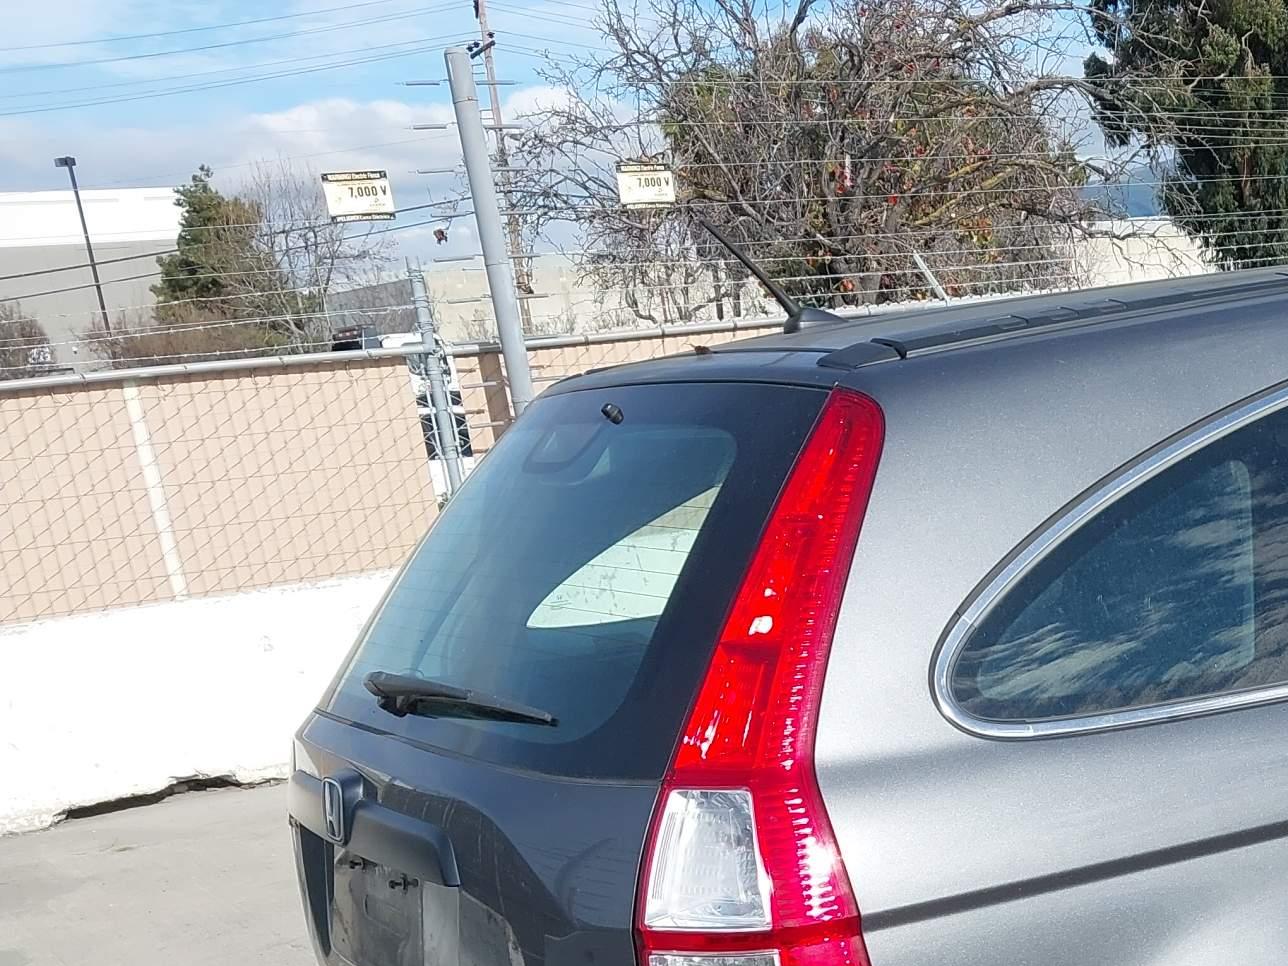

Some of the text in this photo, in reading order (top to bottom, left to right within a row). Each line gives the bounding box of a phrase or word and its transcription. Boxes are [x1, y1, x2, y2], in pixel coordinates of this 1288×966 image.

[636, 177, 670, 189] 7,000 V
[348, 185, 387, 199] 7,000 V
